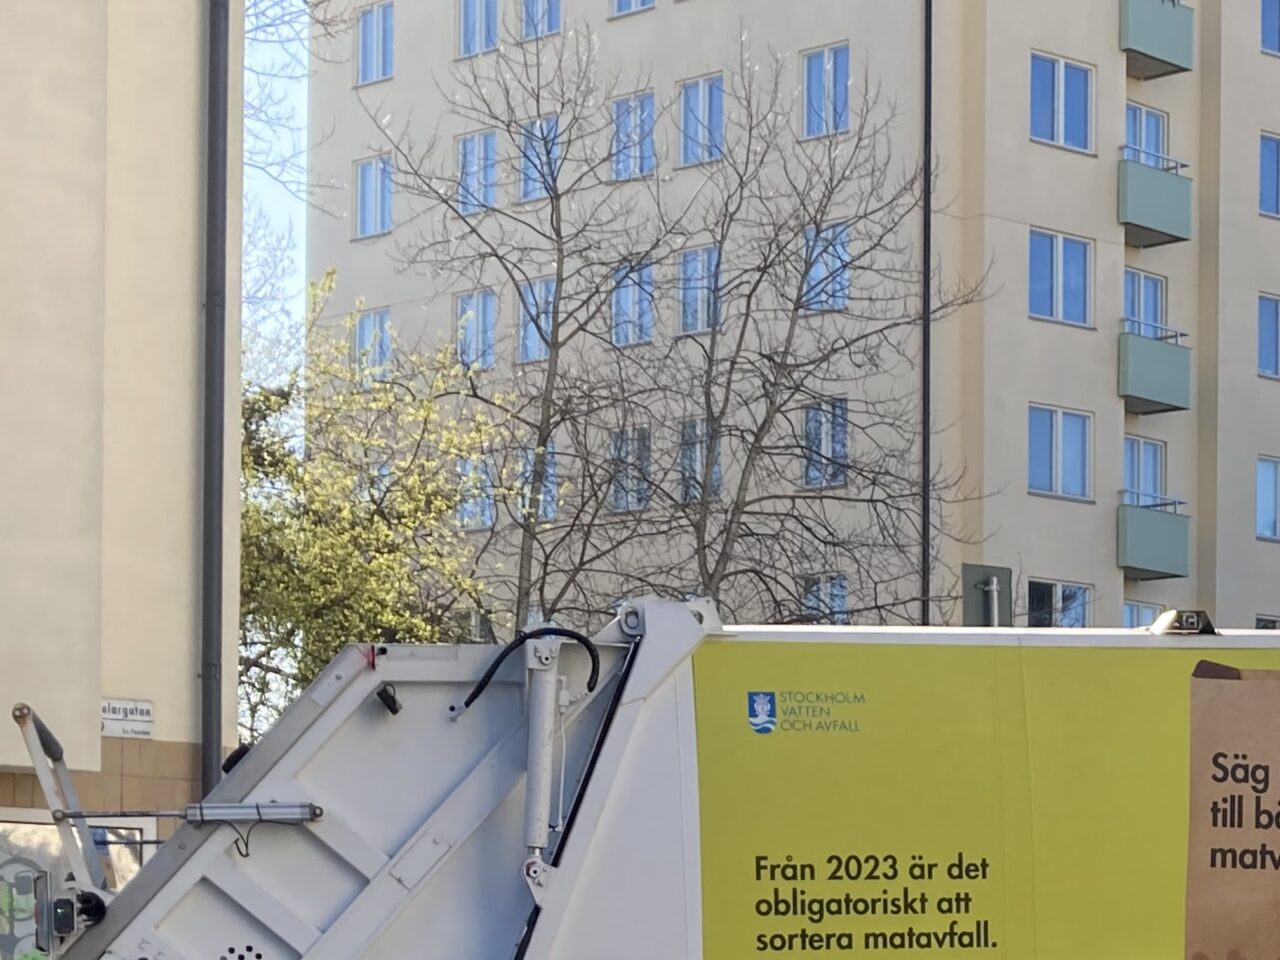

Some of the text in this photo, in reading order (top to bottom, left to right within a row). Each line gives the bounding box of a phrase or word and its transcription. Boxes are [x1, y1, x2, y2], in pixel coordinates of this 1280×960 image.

[779, 690, 866, 704] STOCKHOLM
[780, 705, 831, 718] VATTEN
[780, 719, 861, 733] OCH AVFALL
[1211, 752, 1269, 793] Säg
[1210, 794, 1243, 828] till
[755, 852, 990, 881] Från 2023 är det
[755, 887, 972, 923] obligatoriskt att
[756, 920, 998, 952] sortera matavfall.
